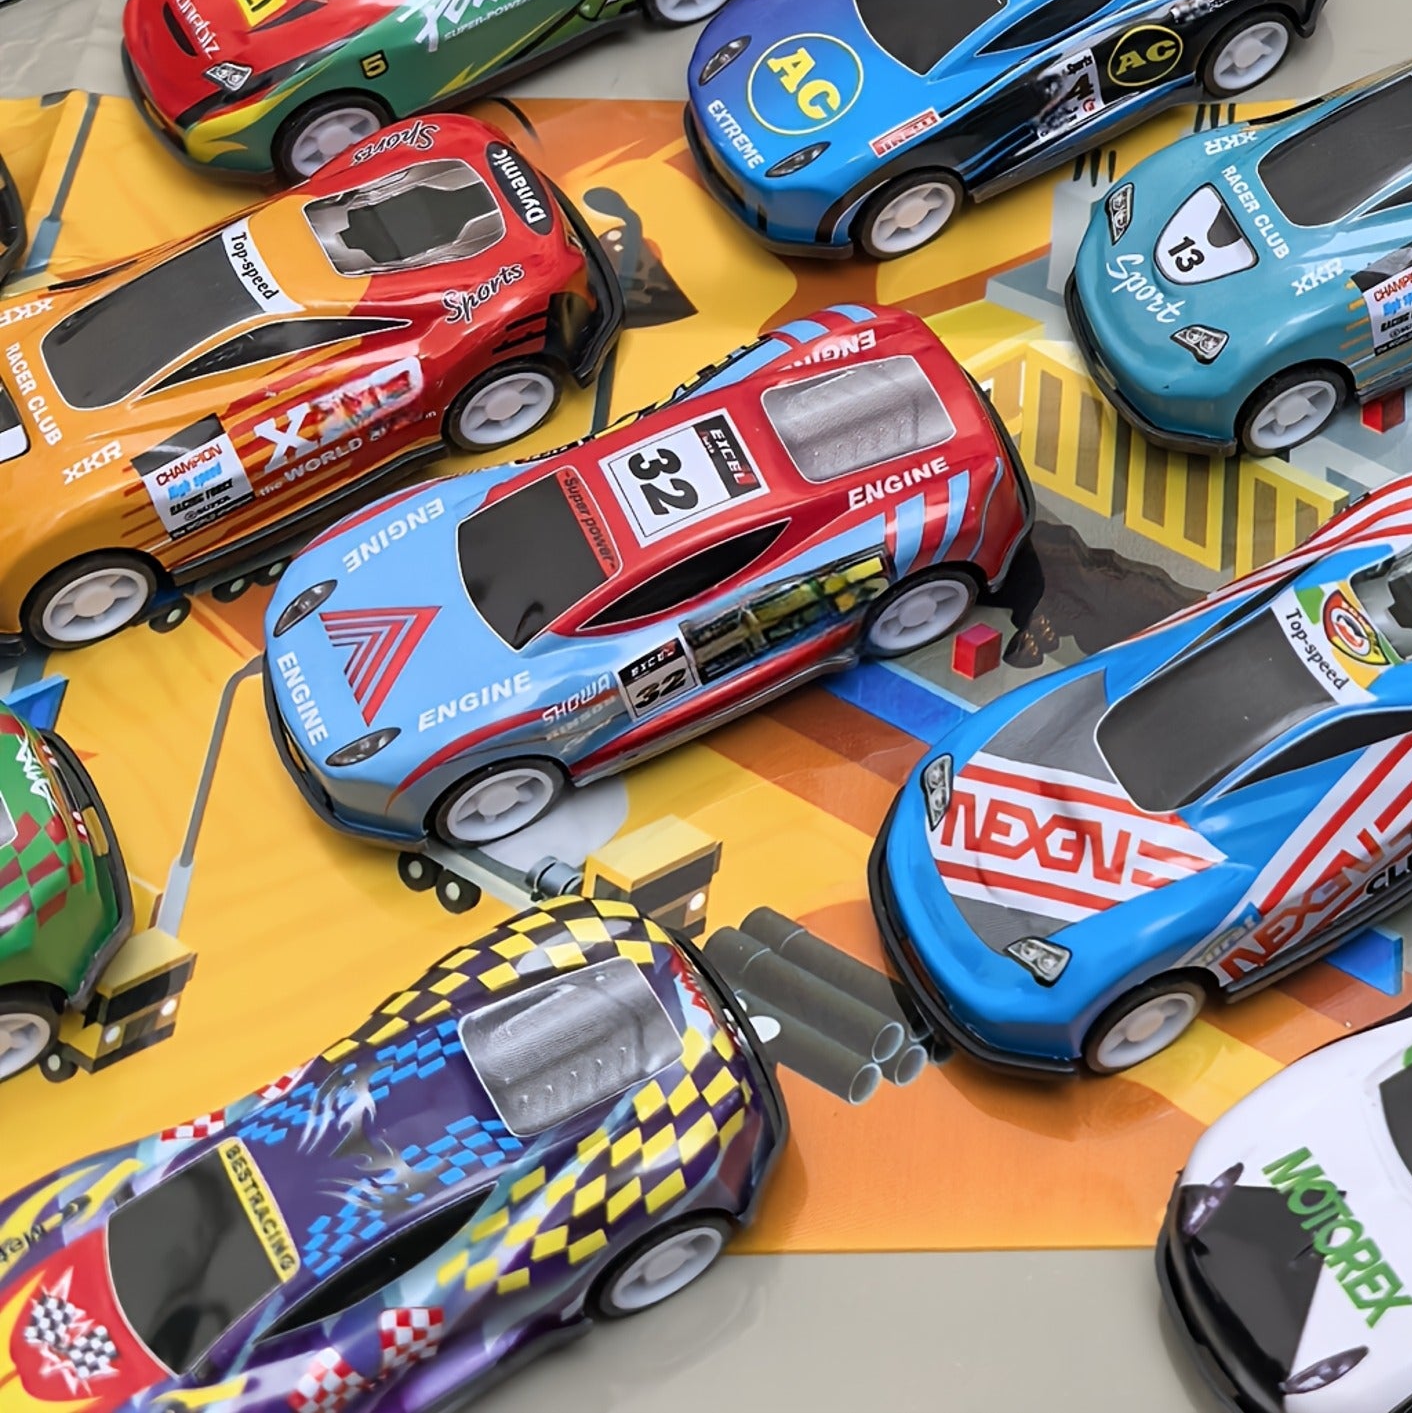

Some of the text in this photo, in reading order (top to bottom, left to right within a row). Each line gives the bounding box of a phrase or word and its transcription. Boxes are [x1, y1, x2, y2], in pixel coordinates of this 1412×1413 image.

[362, 53, 386, 77] 5
[766, 46, 841, 120] AC
[1115, 39, 1177, 76] AC
[352, 121, 439, 166] Sports
[707, 98, 765, 169] EXTREME
[1204, 131, 1258, 157] XKR
[493, 148, 547, 226] Dynamic
[1220, 165, 1291, 261] RACER CLUB
[230, 231, 280, 301] Top-speed
[1166, 235, 1207, 274] 13
[1290, 257, 1345, 297] XKR
[442, 263, 525, 324] Sports
[1105, 252, 1186, 324] Sport
[5, 342, 63, 447] RACER CLUB
[62, 440, 125, 486] XKR
[156, 443, 224, 487] CHAMPION
[284, 436, 364, 483] WORLD
[627, 446, 700, 518] 32
[709, 428, 747, 486] EXCEL
[847, 456, 951, 512] ENGINE
[342, 497, 446, 575] ENGINE
[1284, 606, 1349, 693] Top-speed
[275, 651, 331, 746] ENGINE
[416, 670, 533, 734] ENGINE
[541, 672, 613, 725] SHOWA
[634, 668, 688, 709] 32
[225, 1144, 297, 1273] BESTRACING
